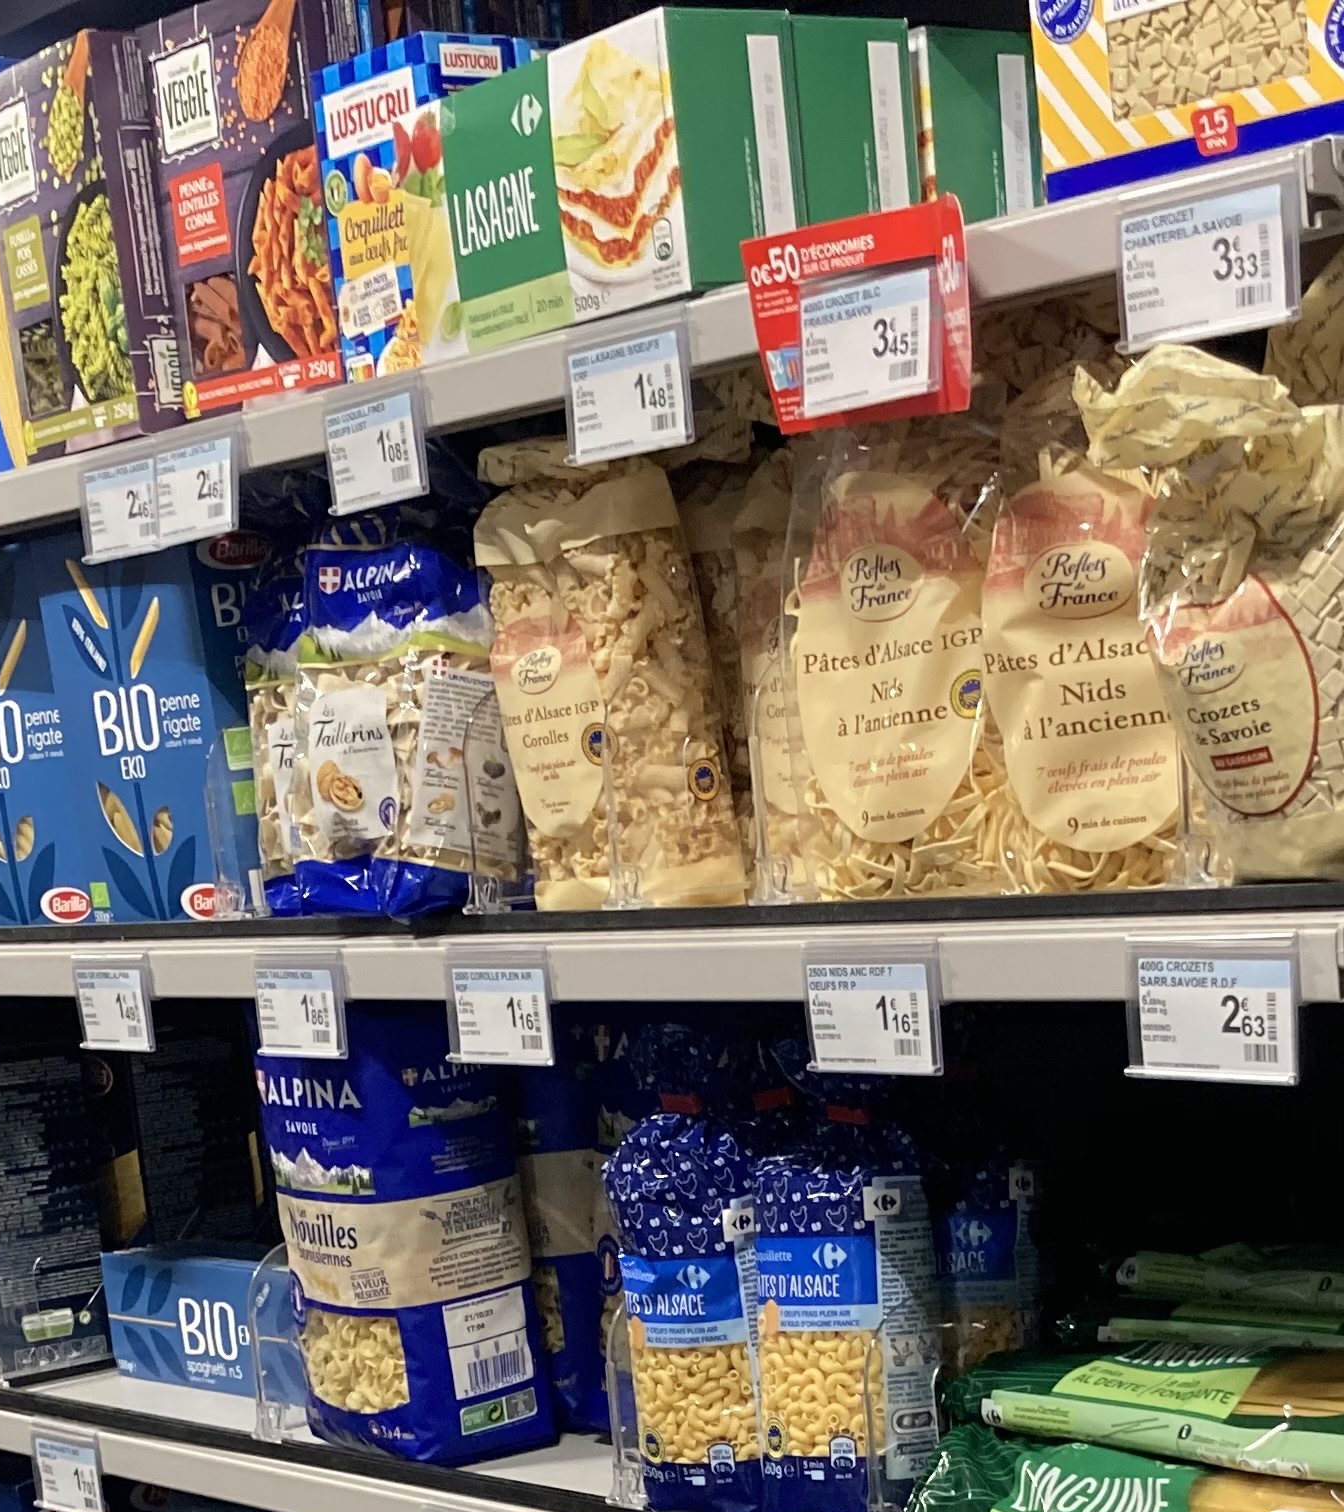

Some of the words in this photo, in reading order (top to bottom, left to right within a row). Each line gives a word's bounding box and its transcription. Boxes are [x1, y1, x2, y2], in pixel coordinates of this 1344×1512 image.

[442, 50, 499, 72] LUSTUCRU
[162, 70, 212, 134] VEGGIE
[330, 88, 411, 143] LUSTUCRU
[1196, 108, 1227, 137] 15
[453, 167, 540, 257] LASAGNE
[800, 234, 876, 264] D'ÉCONOMIES
[574, 296, 602, 315] 500g
[307, 360, 336, 381] 250g
[850, 584, 914, 607] France
[1039, 585, 1121, 608] France
[803, 649, 862, 676] Pâtes
[865, 634, 935, 668] d'Alsace
[940, 625, 983, 651] IGP
[870, 677, 905, 704] Nids
[1059, 680, 1128, 707] Nids
[92, 682, 158, 758] BIO
[159, 692, 201, 725] penne
[852, 703, 949, 736] l'ancienne
[1186, 697, 1262, 727] Crozets
[25, 709, 60, 739] penne
[162, 710, 202, 741] rigate
[314, 716, 385, 750] Taillerins
[26, 727, 63, 751] rigate
[522, 728, 570, 748] Corolles
[120, 755, 145, 780] EKO
[52, 896, 87, 916] Barilla
[808, 967, 827, 979] 250G
[828, 967, 848, 979] NIDS
[849, 966, 867, 978] ANC
[868, 966, 887, 978] RDF
[1139, 961, 1165, 973] 400G
[1166, 961, 1215, 973] CROZETS
[809, 981, 835, 992] OEUFS
[267, 1076, 363, 1111] ALPINA
[285, 1119, 318, 1136] SAVOIE
[290, 1218, 358, 1250] Nouilles
[351, 1276, 389, 1291] SAVEUR
[178, 1298, 239, 1362] BIO
[186, 1360, 227, 1381] spaghetti
[1094, 1375, 1146, 1393] DENTE
